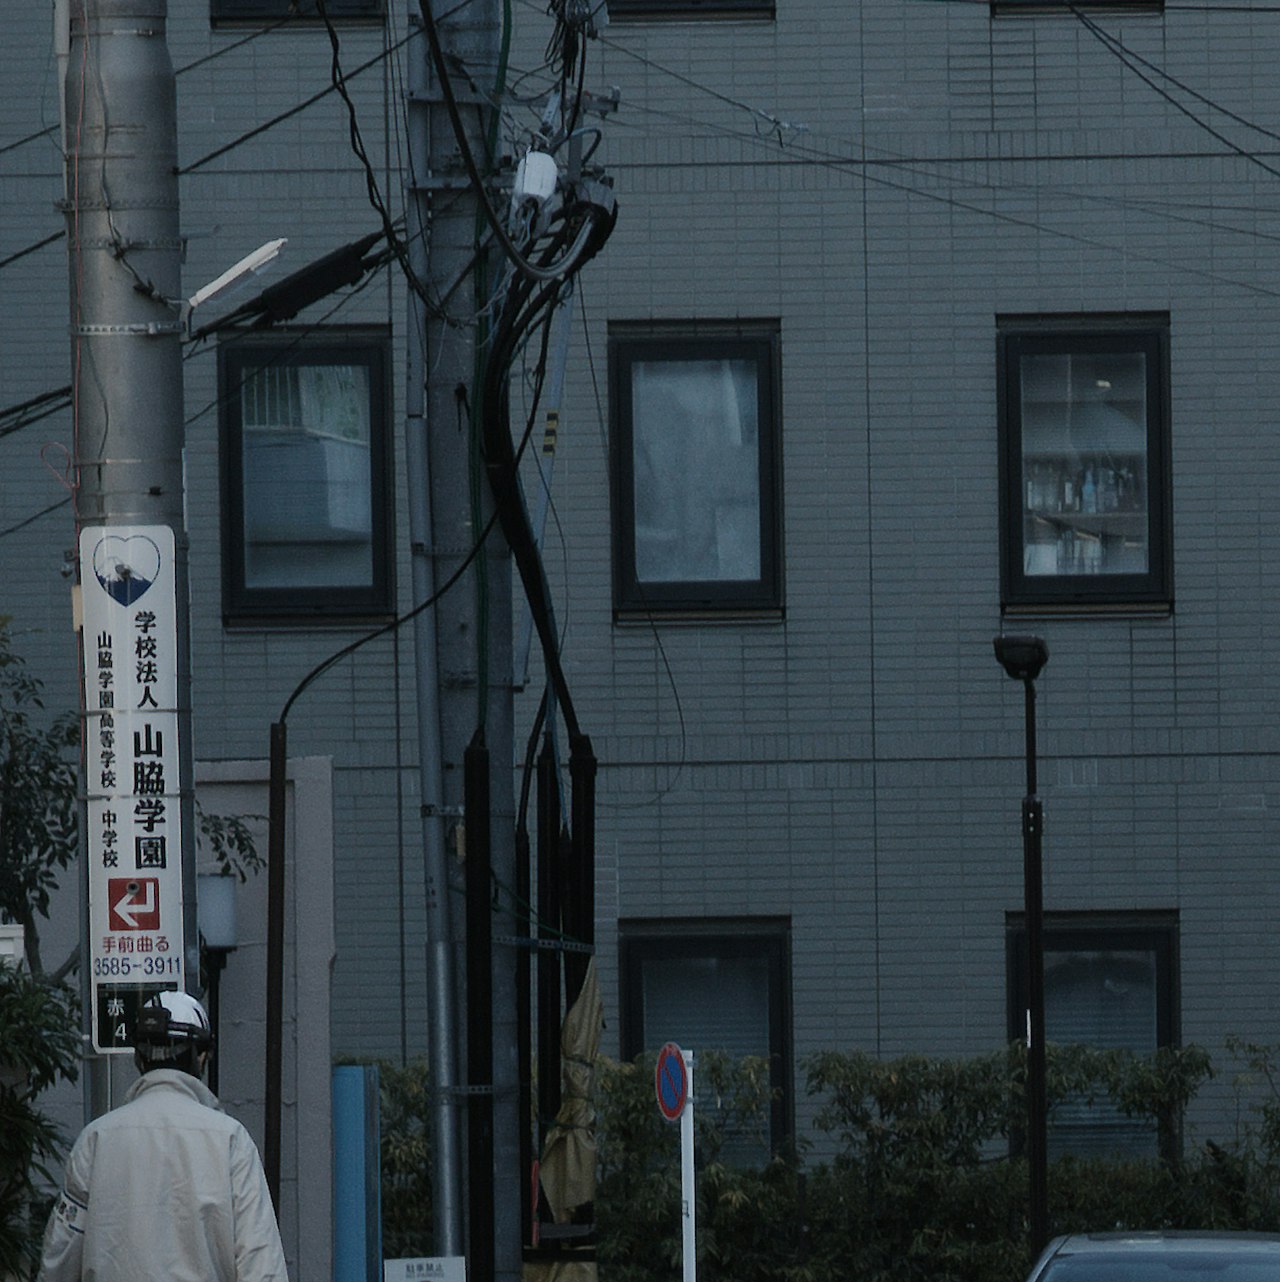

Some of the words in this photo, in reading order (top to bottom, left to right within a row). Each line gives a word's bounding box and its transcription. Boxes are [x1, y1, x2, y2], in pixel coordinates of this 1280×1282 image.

[102, 936, 170, 954] 手前曲る
[94, 956, 182, 977] 3585-3911
